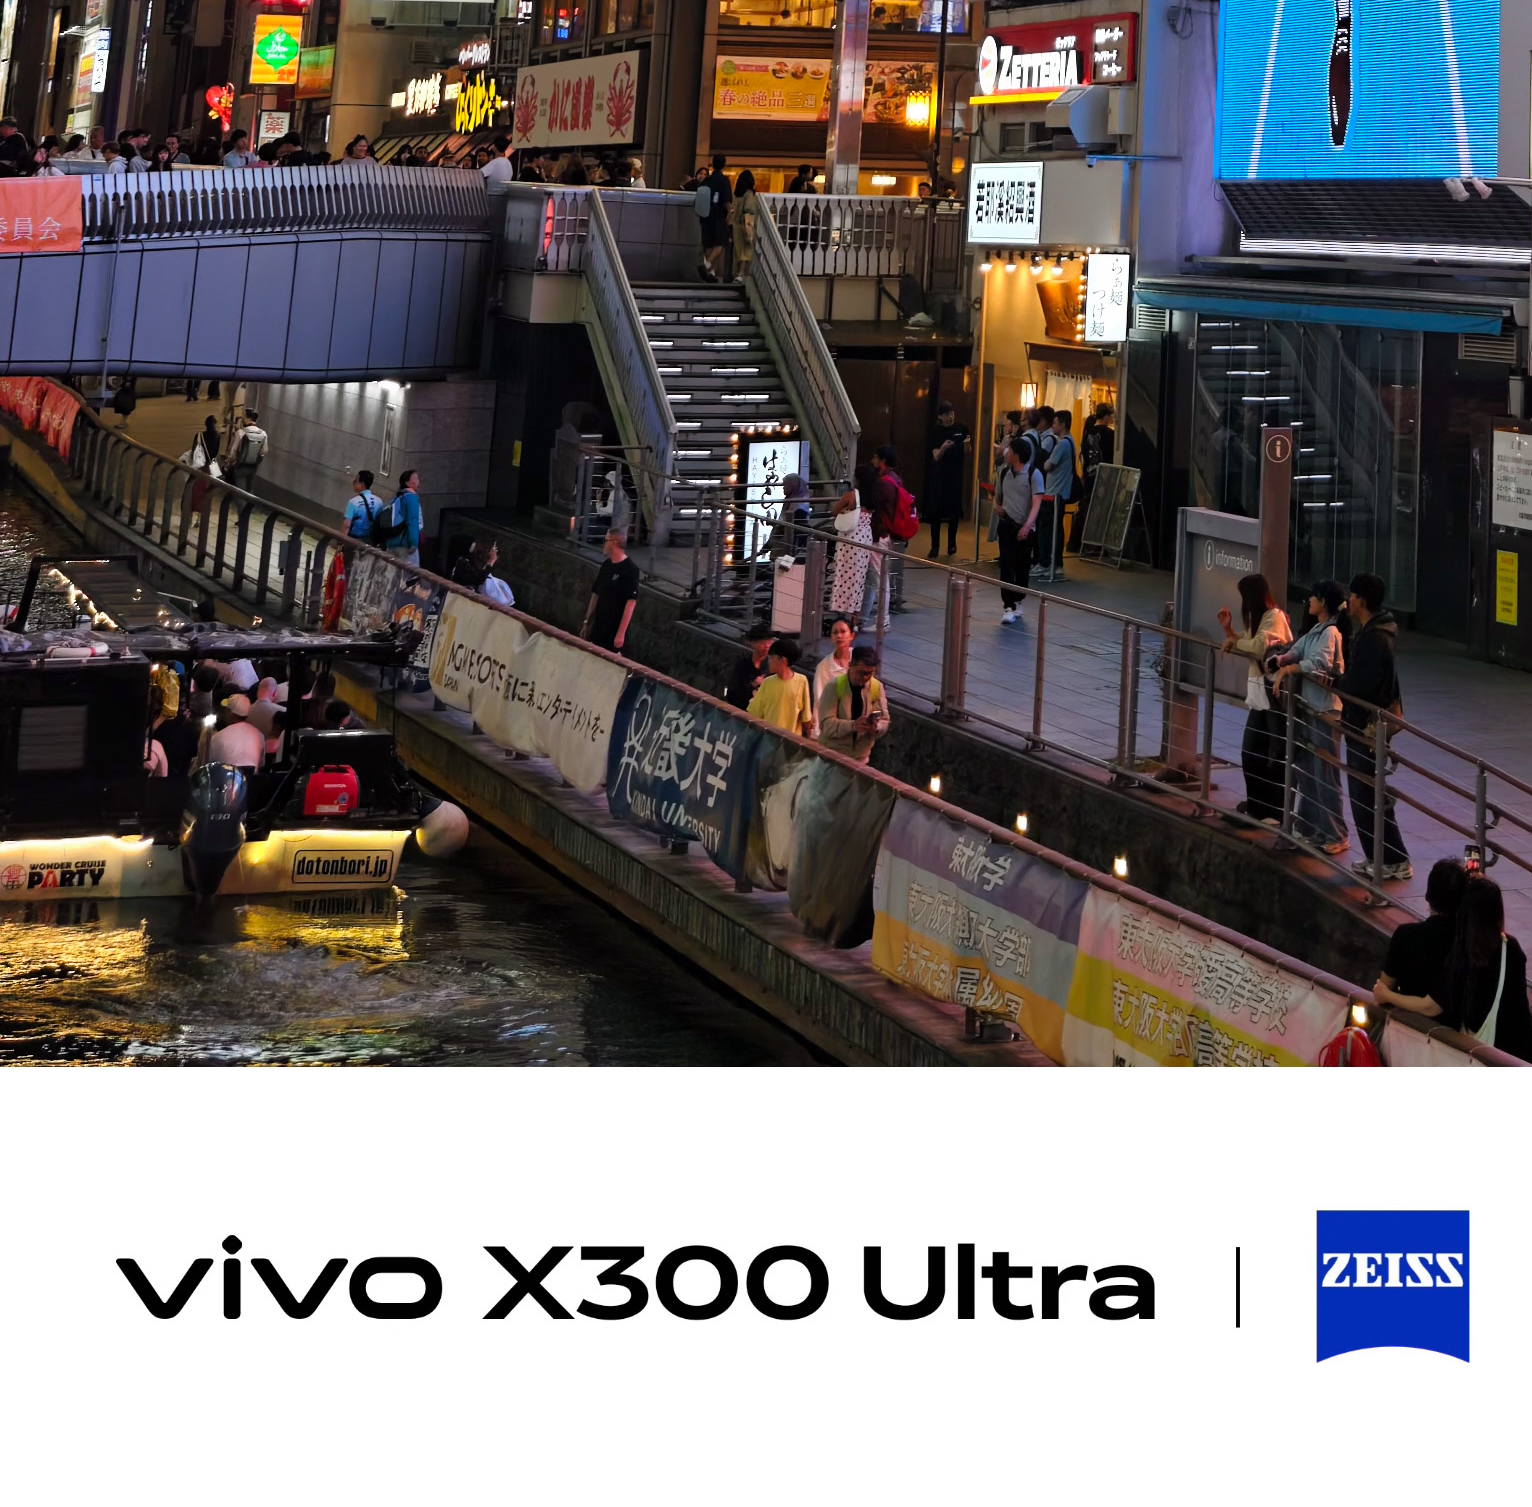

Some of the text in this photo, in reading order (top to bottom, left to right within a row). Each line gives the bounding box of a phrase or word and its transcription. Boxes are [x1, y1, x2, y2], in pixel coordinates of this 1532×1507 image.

[998, 44, 1079, 91] ZETTERIA
[0, 216, 62, 241] 員会
[1215, 548, 1254, 572] information
[29, 859, 107, 871] WONDER CRUISE
[296, 854, 388, 878] dotonbori.jp
[27, 867, 105, 890] PARTY
